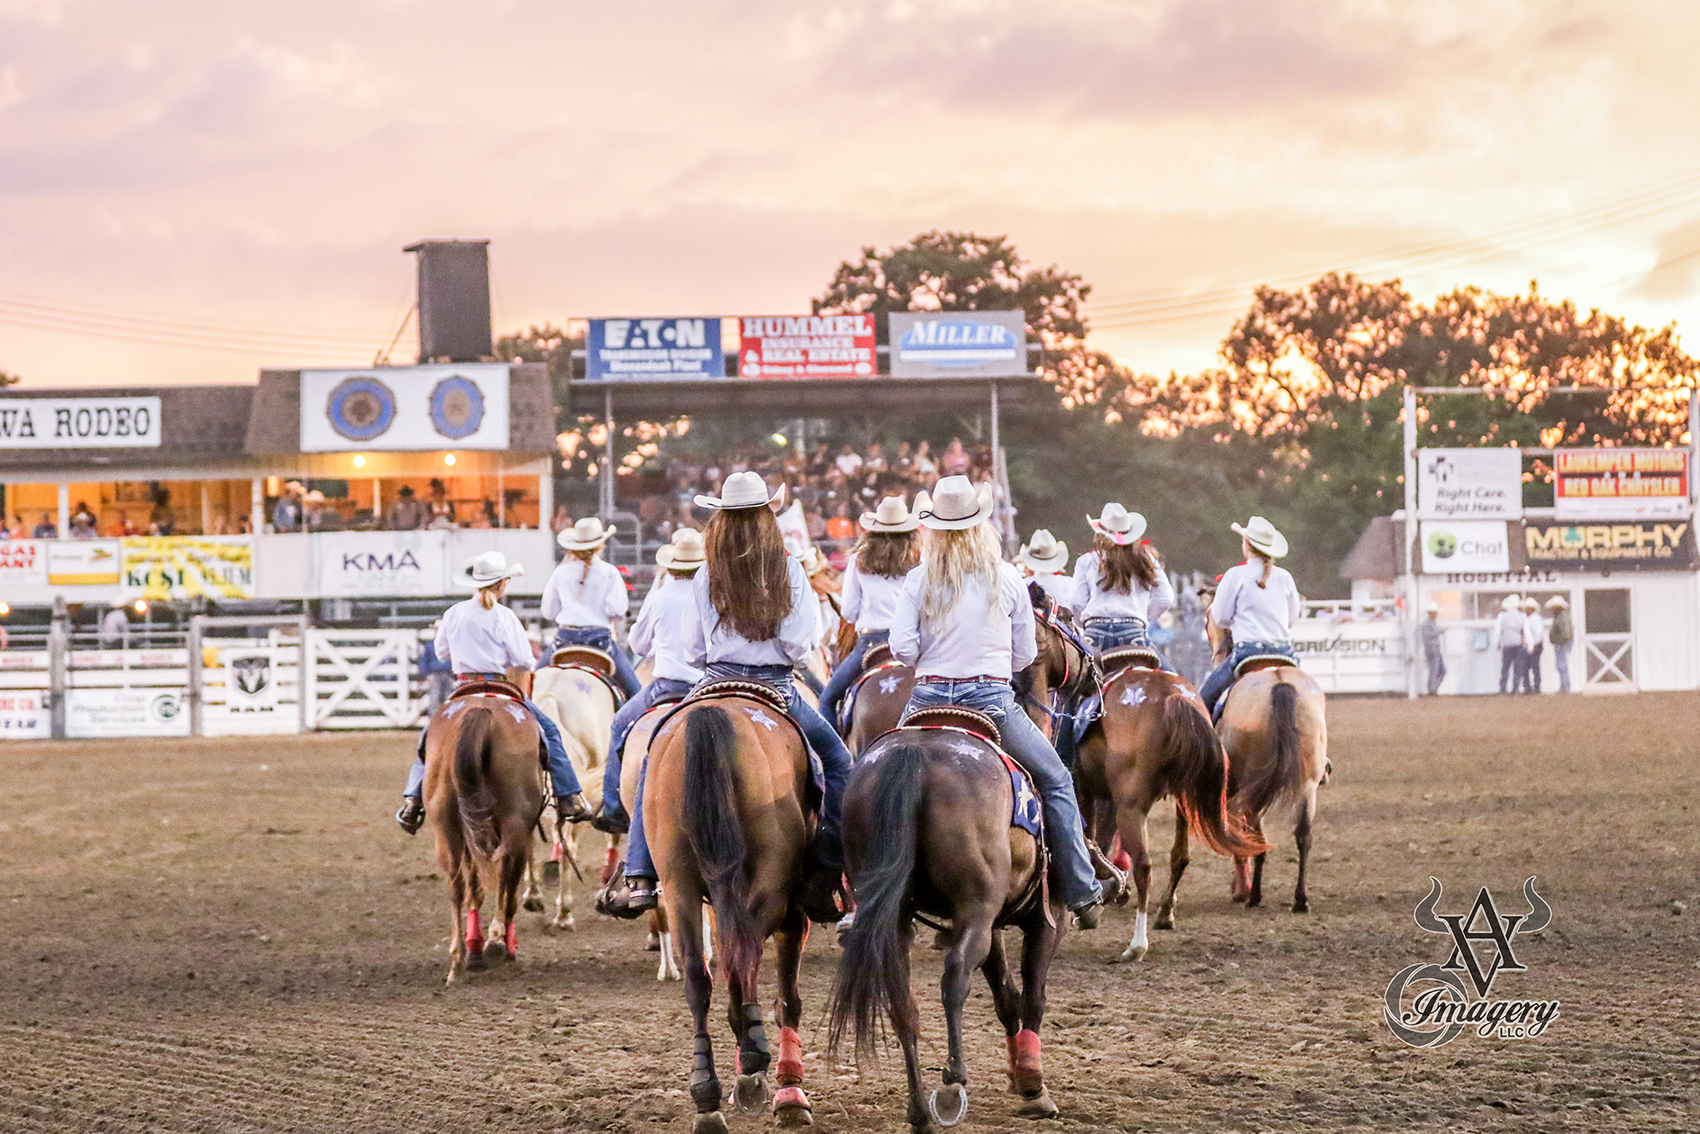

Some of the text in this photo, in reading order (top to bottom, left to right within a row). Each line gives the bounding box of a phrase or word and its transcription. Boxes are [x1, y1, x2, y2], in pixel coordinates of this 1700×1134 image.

[605, 320, 706, 348] EATON
[743, 316, 872, 337] HUMMEL
[908, 320, 1007, 344] MILLER
[762, 337, 854, 349] INSURANCE
[762, 349, 806, 362] REAL
[808, 348, 871, 361] ESTATE
[55, 407, 150, 437] RODEO
[1634, 452, 1684, 471] MOTORS
[1437, 487, 1470, 500] Right
[1564, 478, 1680, 496] RED OAK CHRYSLER
[1435, 502, 1468, 514] Right
[1526, 523, 1687, 549] MURPHY
[343, 550, 420, 570] KMA
[90, 713, 146, 723] Services
